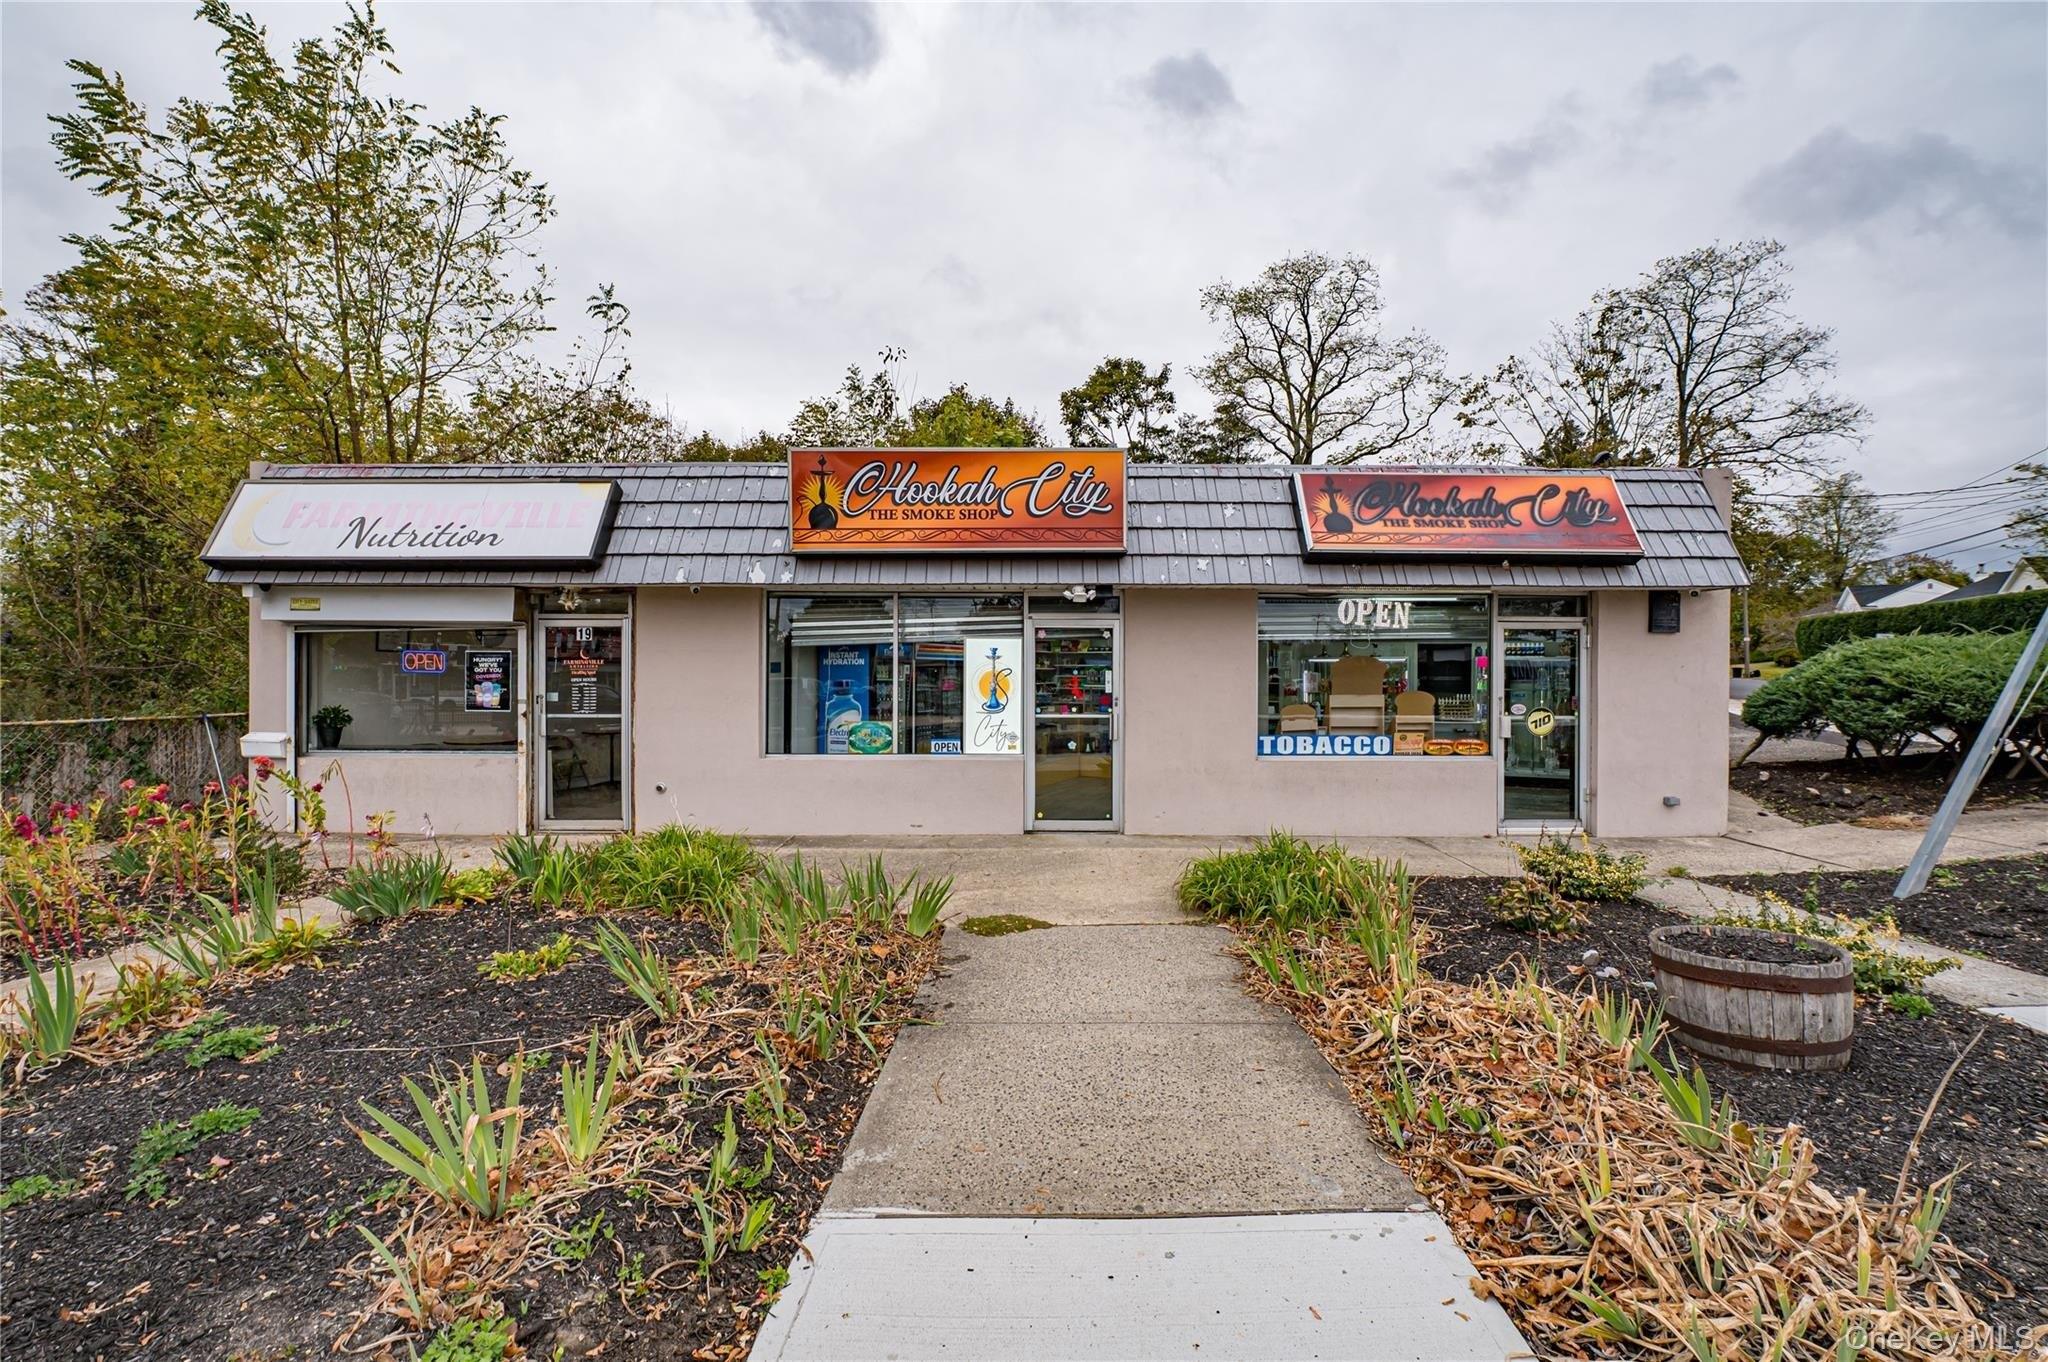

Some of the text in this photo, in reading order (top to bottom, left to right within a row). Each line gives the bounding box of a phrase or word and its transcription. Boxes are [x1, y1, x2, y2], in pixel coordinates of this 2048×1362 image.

[842, 461, 1113, 519] Hookah City
[1352, 480, 1618, 528] Hookah City
[282, 499, 593, 529] FARMINGVILLE
[869, 508, 999, 521] THE SMOKE SHOP
[1382, 518, 1506, 529] THE SMOKE SHOP
[336, 516, 504, 549] Nutrition
[1338, 599, 1411, 628] OPEN
[578, 628, 591, 640] 19
[405, 653, 442, 670] OPEN
[1530, 714, 1551, 730] 710
[974, 715, 1007, 752] City
[934, 742, 958, 752] OPEN
[1260, 736, 1391, 755] TOBACCO
